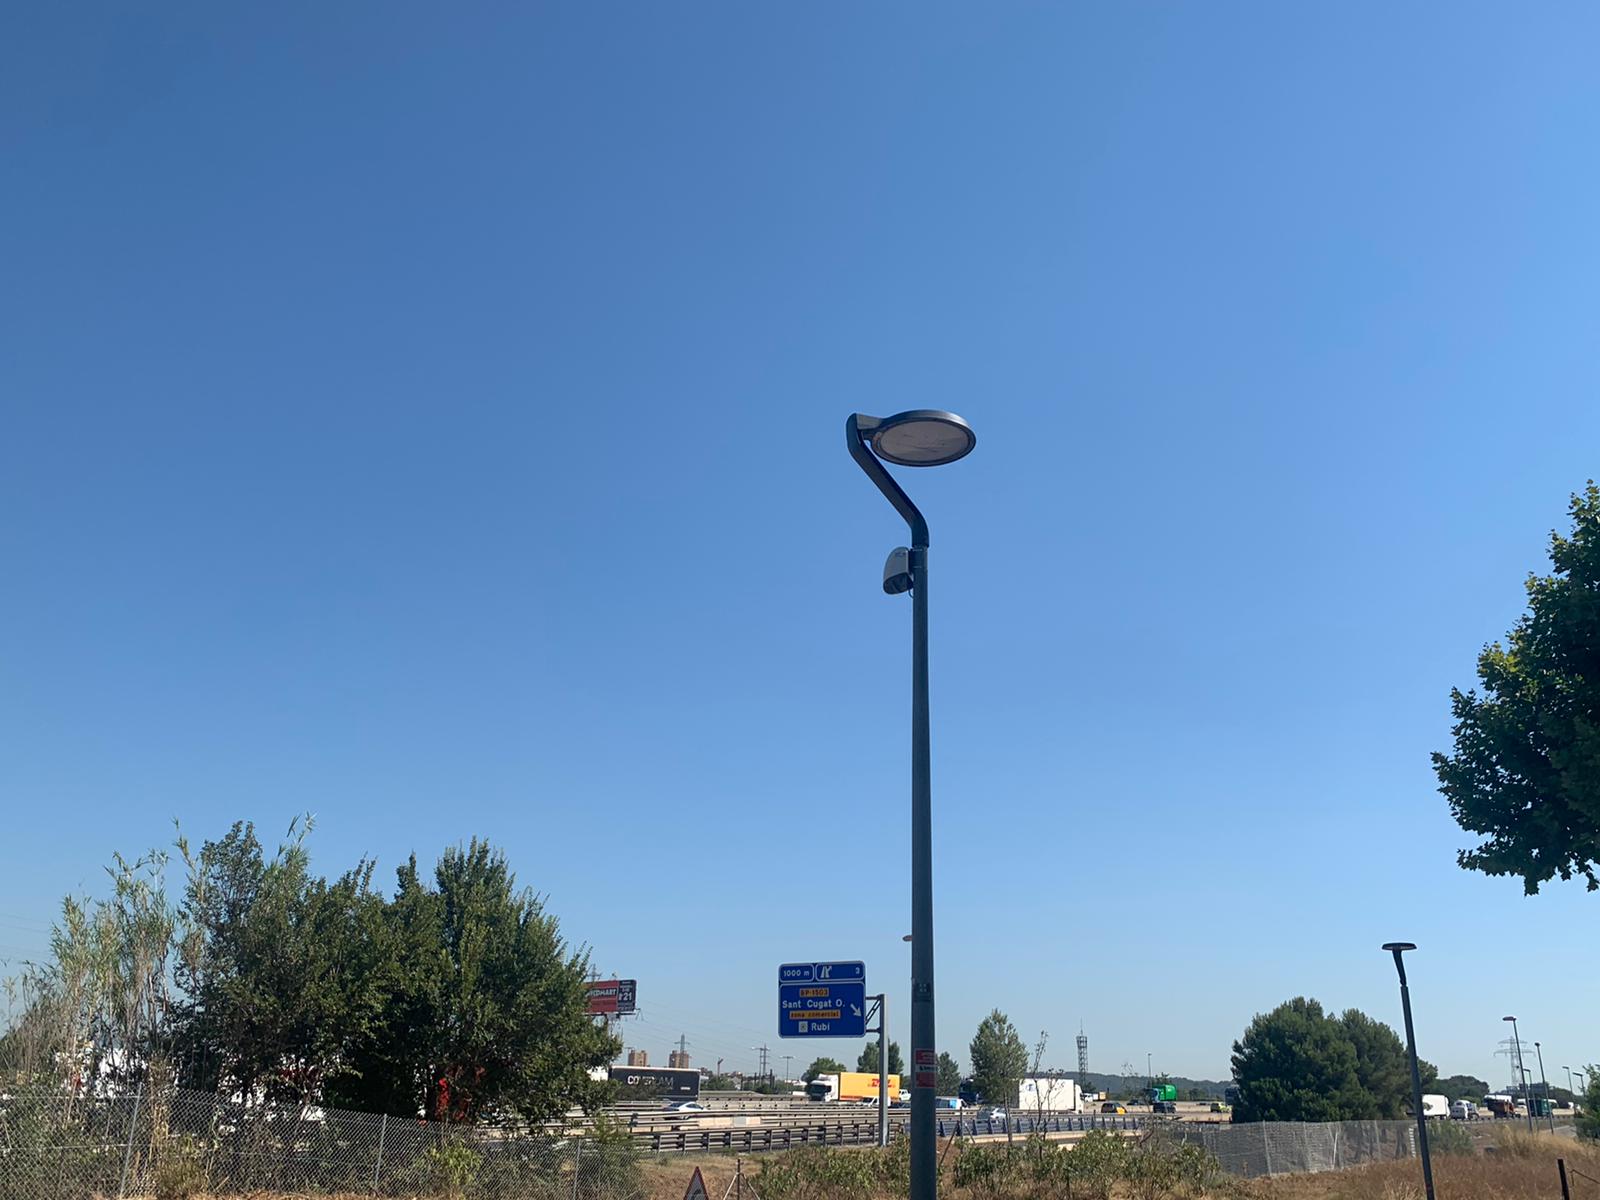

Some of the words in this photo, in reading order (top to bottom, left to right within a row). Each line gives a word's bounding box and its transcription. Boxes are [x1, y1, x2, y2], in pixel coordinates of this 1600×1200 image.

[782, 1000, 801, 1008] Sant
[807, 999, 832, 1009] Cugat
[836, 999, 845, 1007] O.
